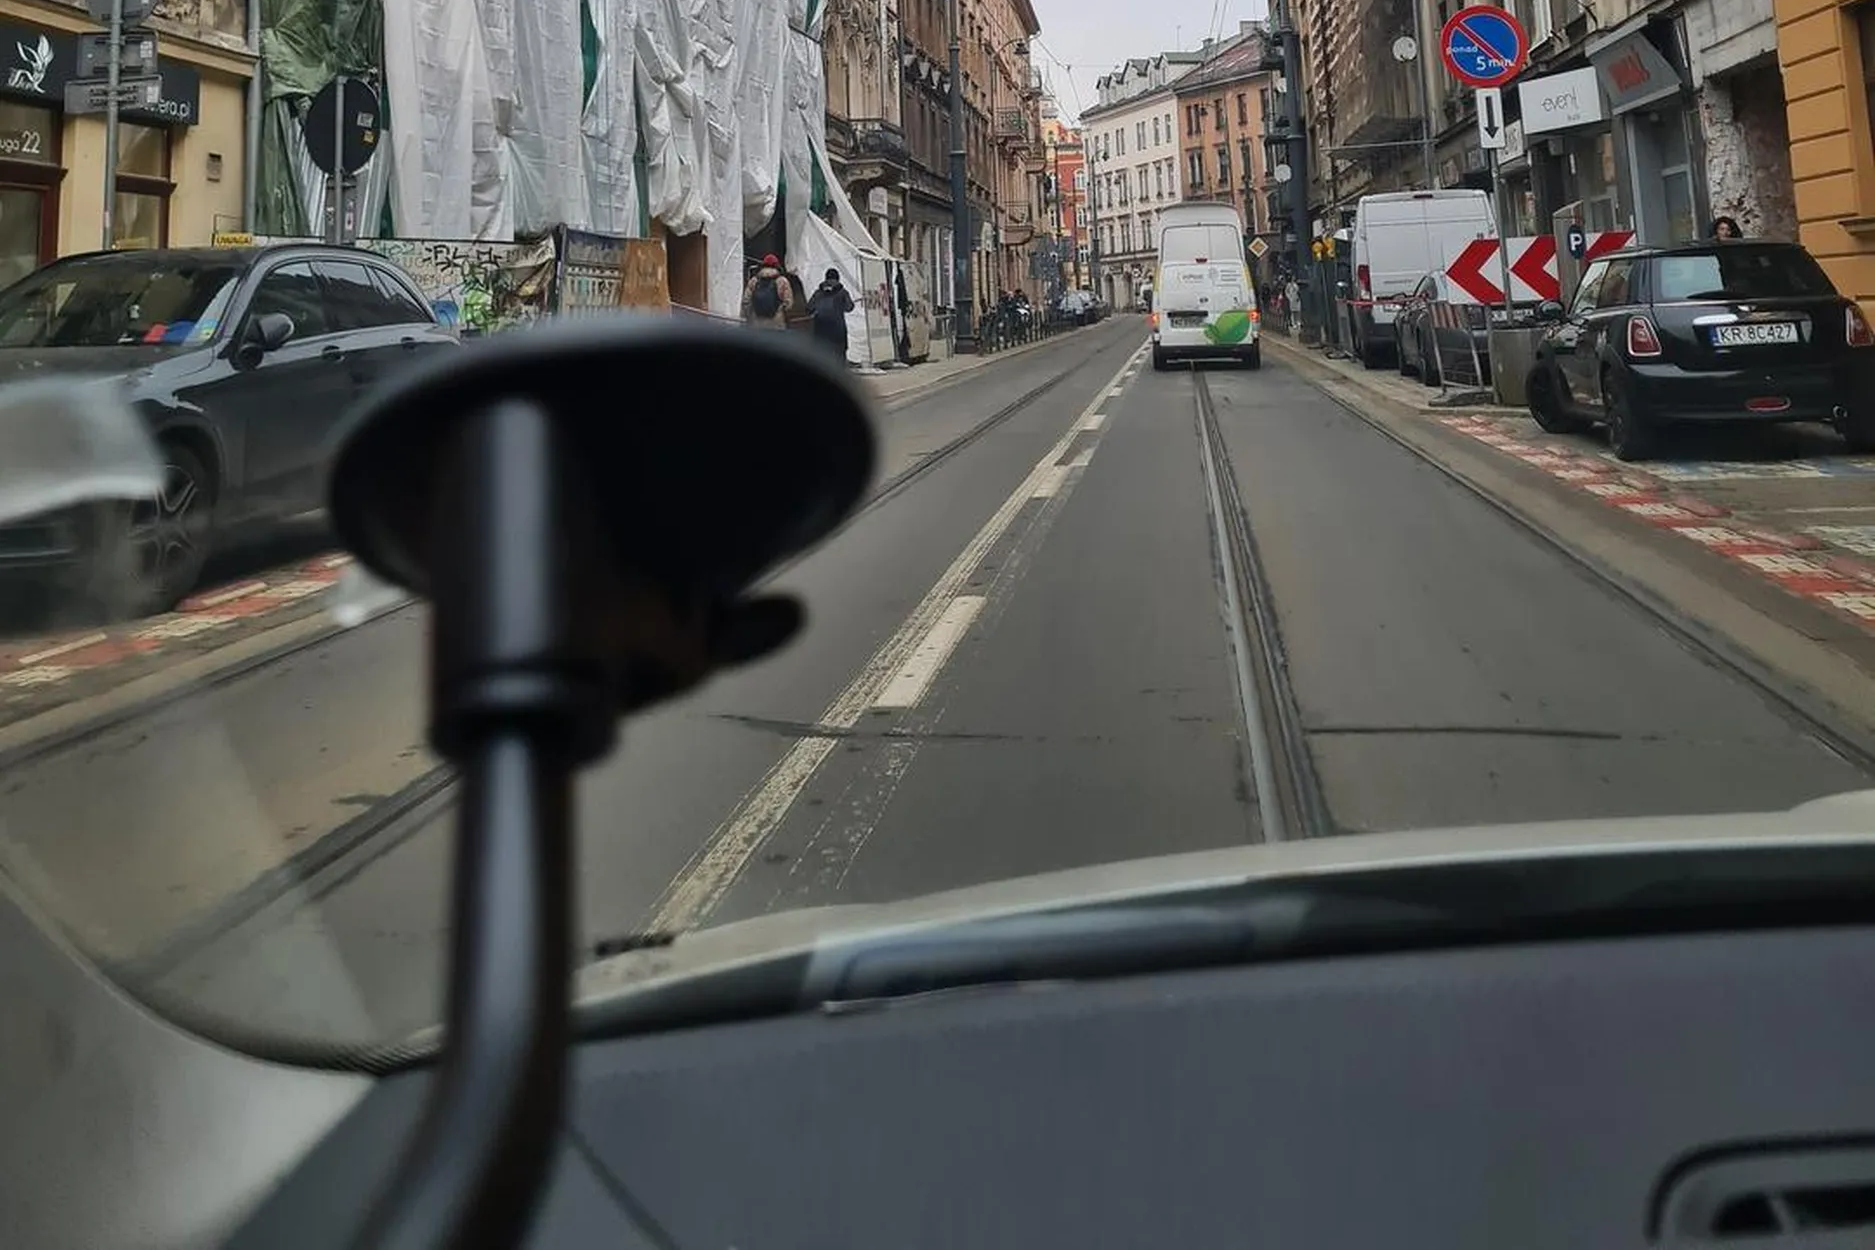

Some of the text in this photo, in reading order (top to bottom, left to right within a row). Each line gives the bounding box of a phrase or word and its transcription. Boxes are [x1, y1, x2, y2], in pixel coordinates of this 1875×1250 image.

[1476, 56, 1486, 70] 5
[22, 130, 41, 154] 22
[1570, 233, 1582, 251] P
[1720, 327, 1743, 342] KR
